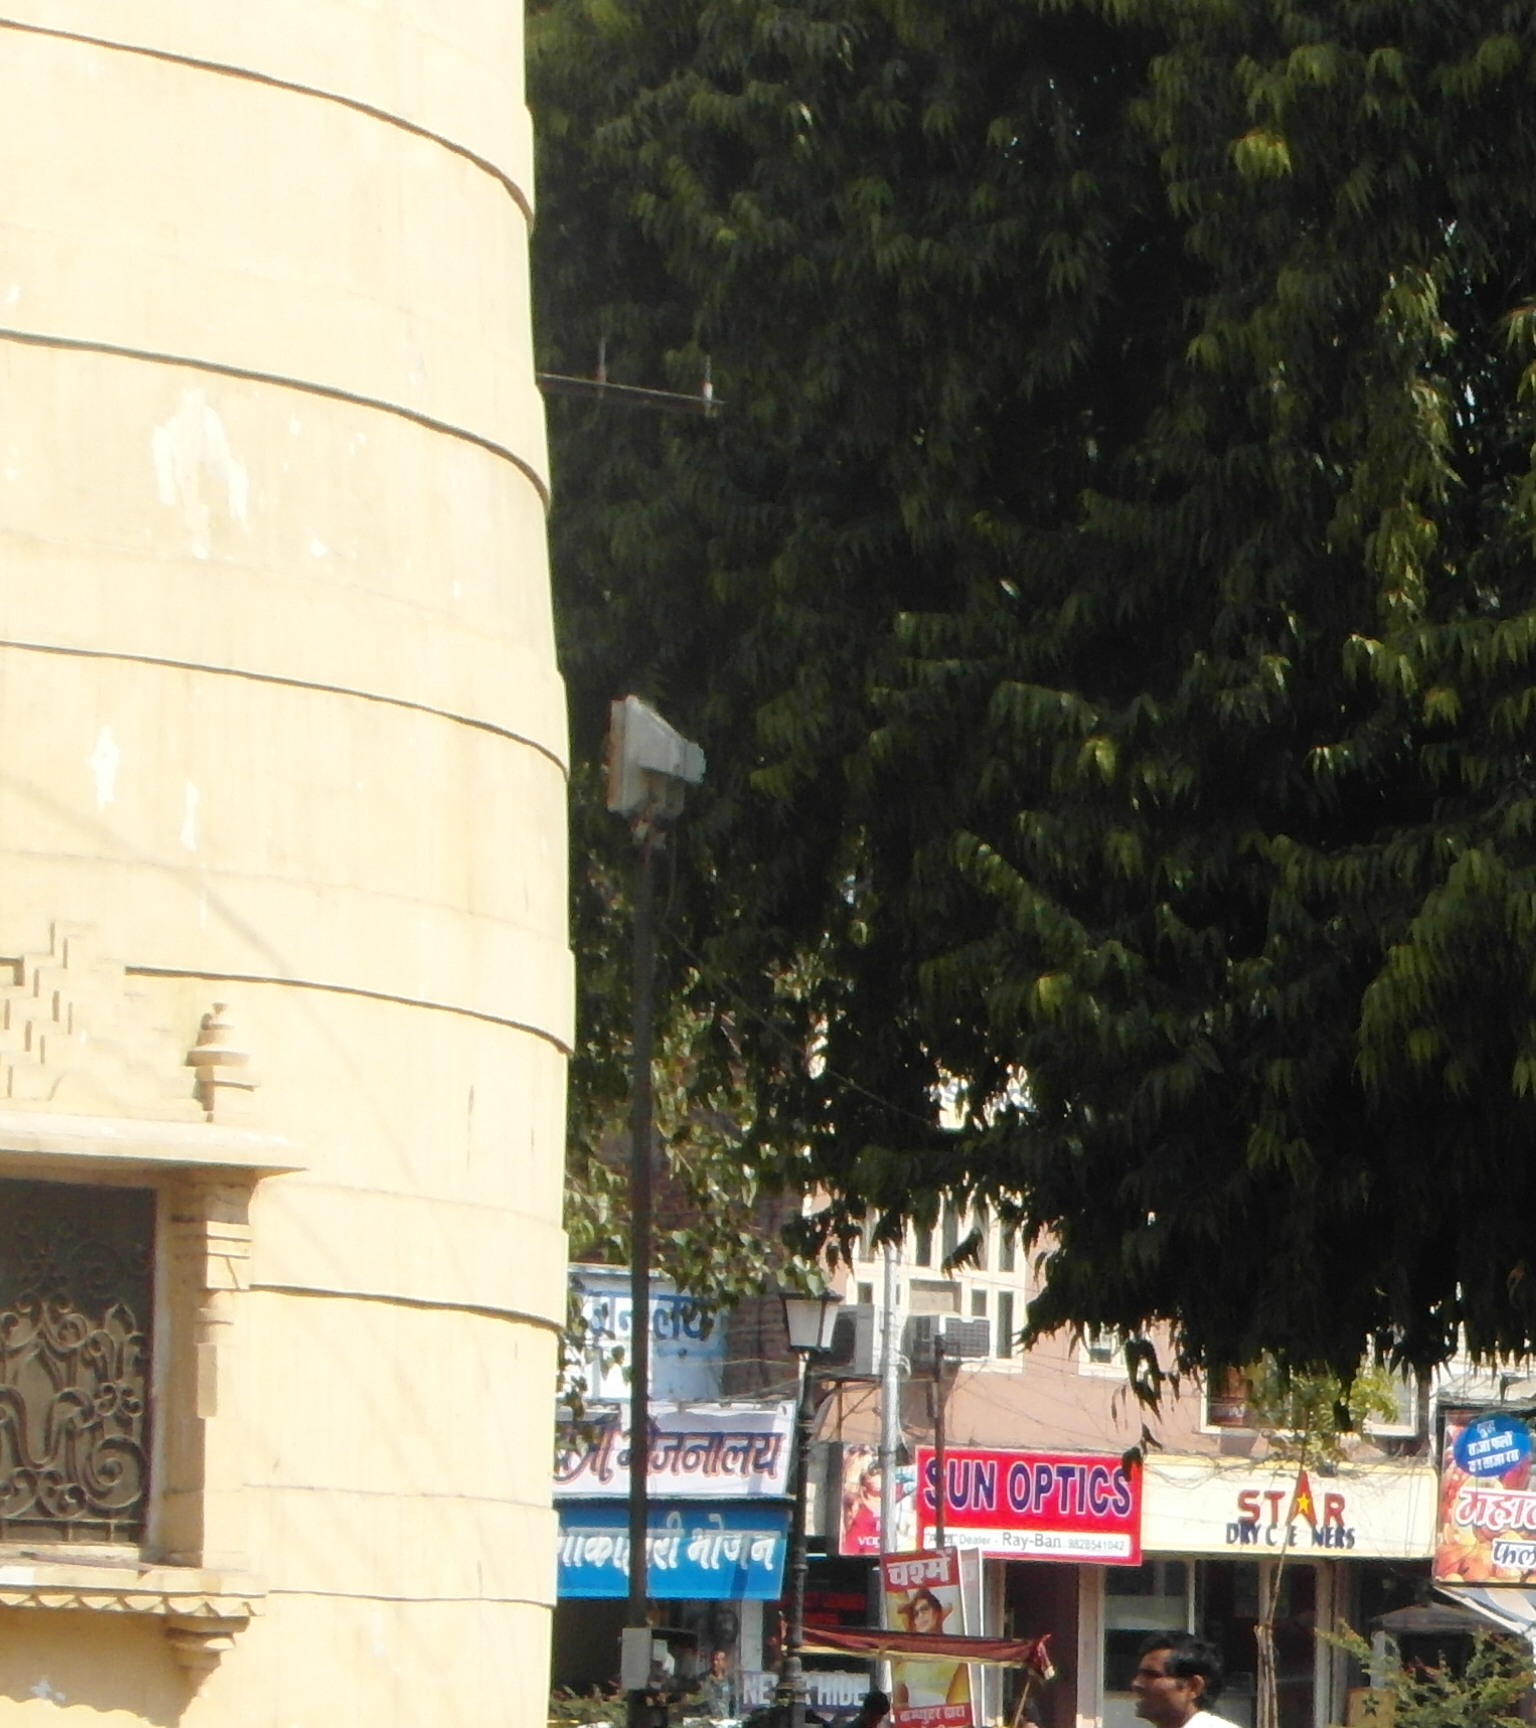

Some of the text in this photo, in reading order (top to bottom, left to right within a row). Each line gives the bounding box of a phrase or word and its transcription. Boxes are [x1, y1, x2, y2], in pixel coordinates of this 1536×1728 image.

[922, 1456, 1132, 1519] SUN OPTICS
[1237, 1470, 1346, 1527] STAR
[687, 1512, 782, 1571] भोजन
[959, 1533, 992, 1546] Dealer
[1002, 1531, 1062, 1551] Ray-Ban
[1225, 1521, 1261, 1545] DRY
